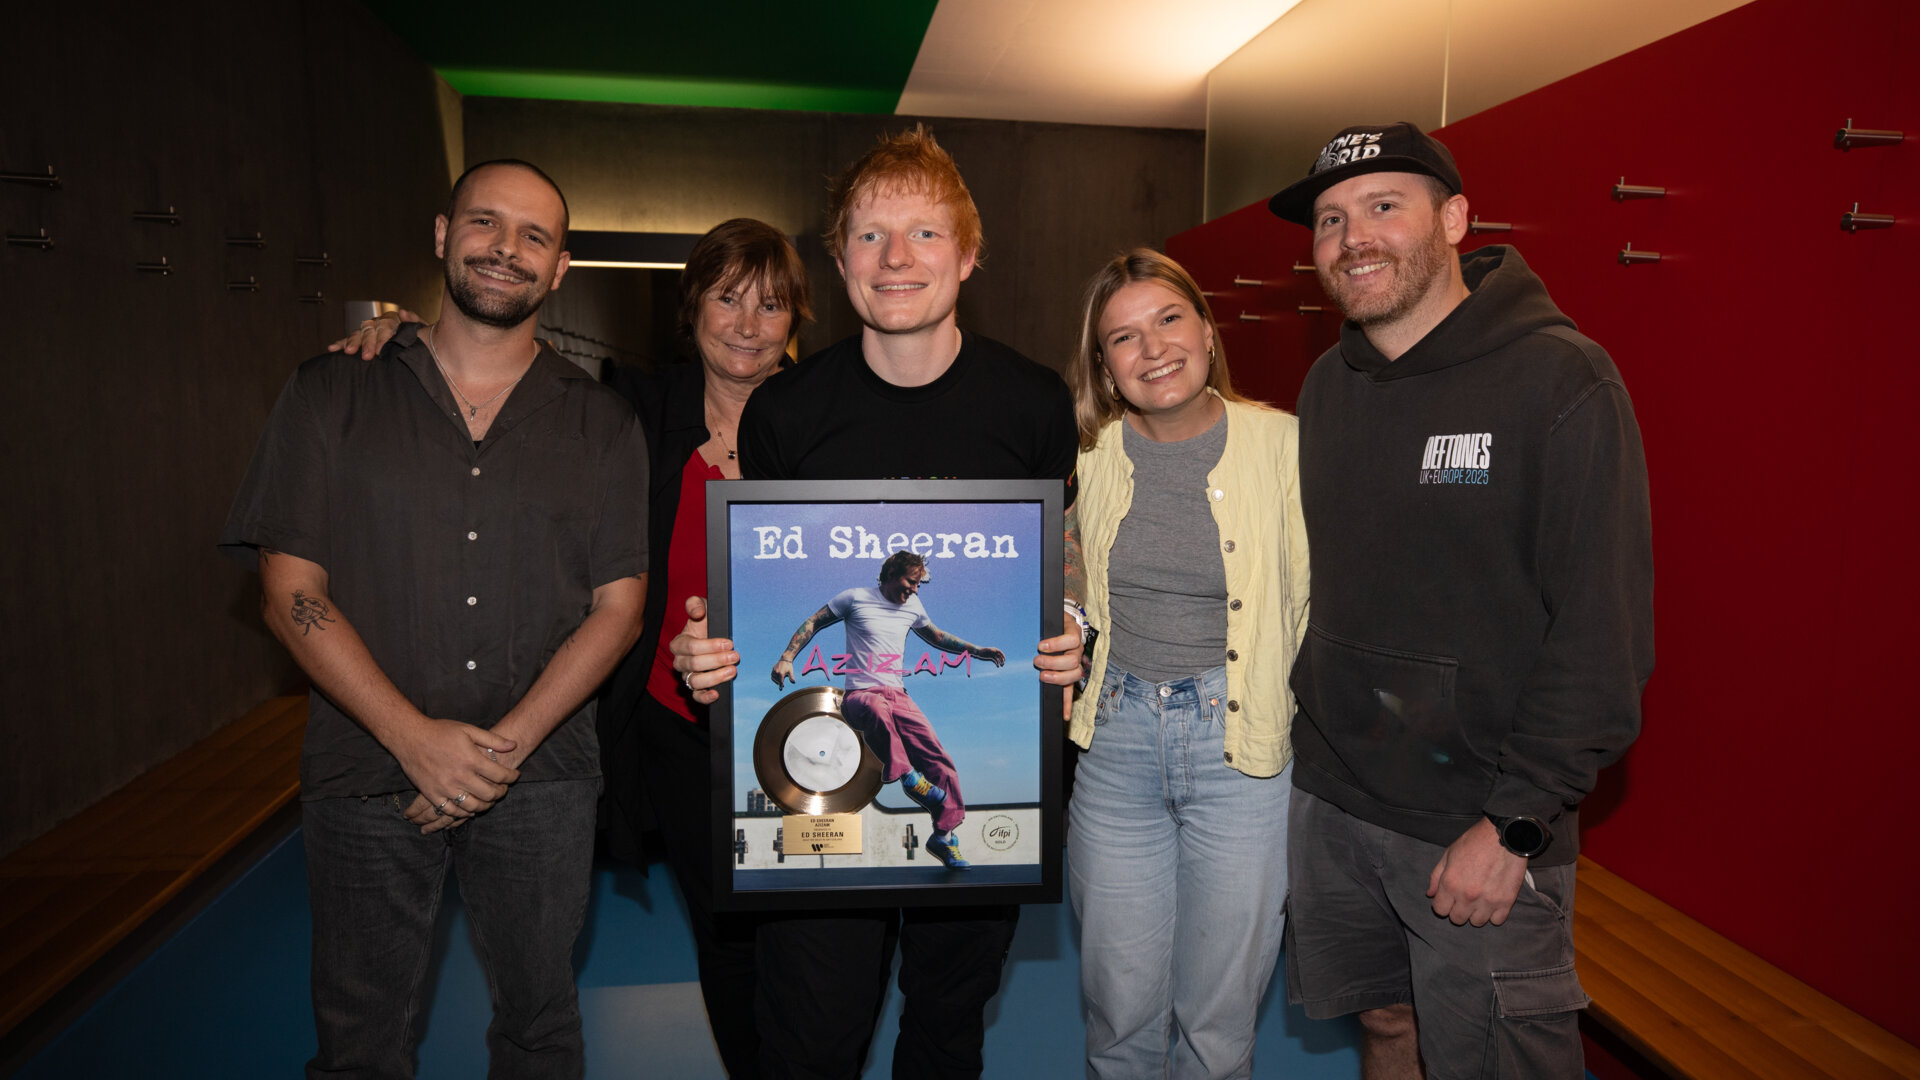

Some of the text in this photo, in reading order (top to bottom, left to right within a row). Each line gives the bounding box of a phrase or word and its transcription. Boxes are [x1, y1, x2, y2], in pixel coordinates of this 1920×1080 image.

[1421, 432, 1493, 470] DEFTONES
[1465, 468, 1490, 485] 2025
[753, 525, 1020, 560] Ed Sheeran
[801, 831, 844, 839] ED SHEERAN
